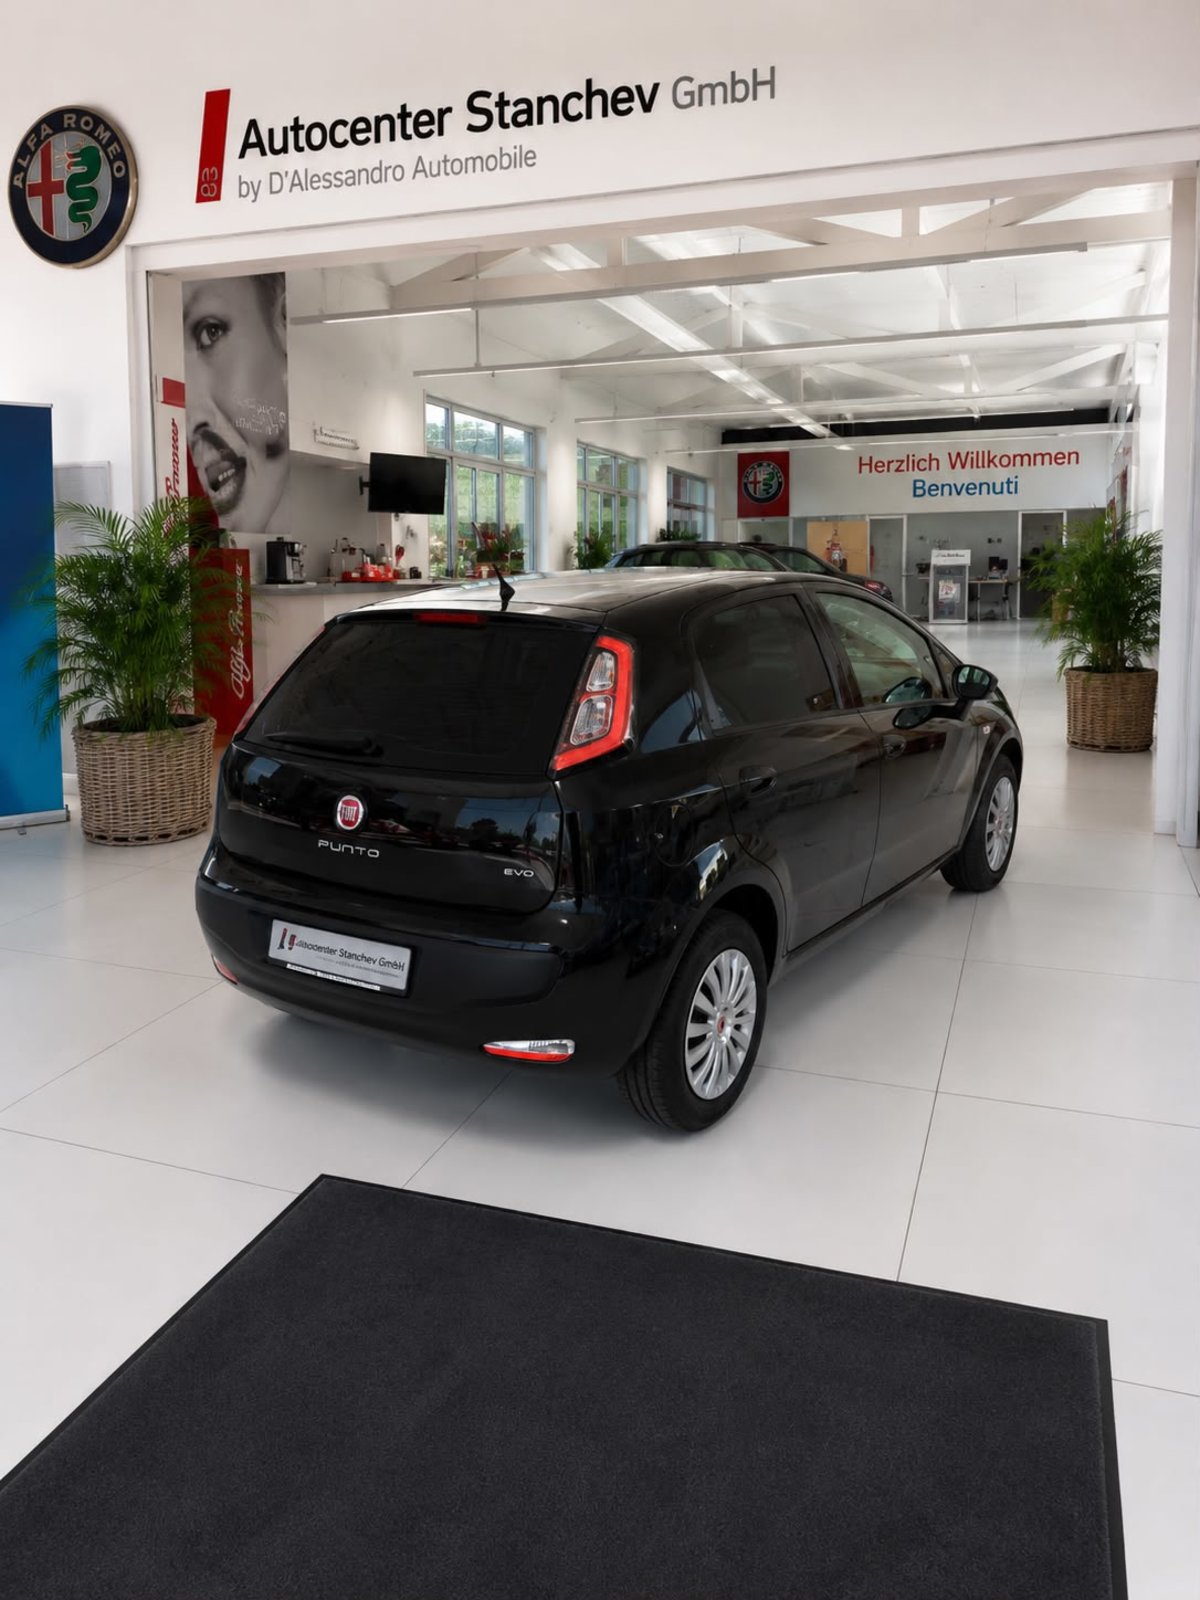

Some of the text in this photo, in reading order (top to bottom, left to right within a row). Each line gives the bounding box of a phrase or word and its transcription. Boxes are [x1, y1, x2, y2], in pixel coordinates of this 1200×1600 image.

[238, 66, 775, 159] Autocenter Stanchev GmbH
[13, 113, 126, 189] ALFA ROMEO
[238, 145, 537, 203] by D'Alessandro Automobile
[858, 450, 1080, 474] Herzlich Willkommen
[912, 475, 1019, 498] Benvenuti
[318, 839, 380, 858] PUNTO
[504, 868, 535, 878] EVO
[338, 948, 378, 966] Stanchev
